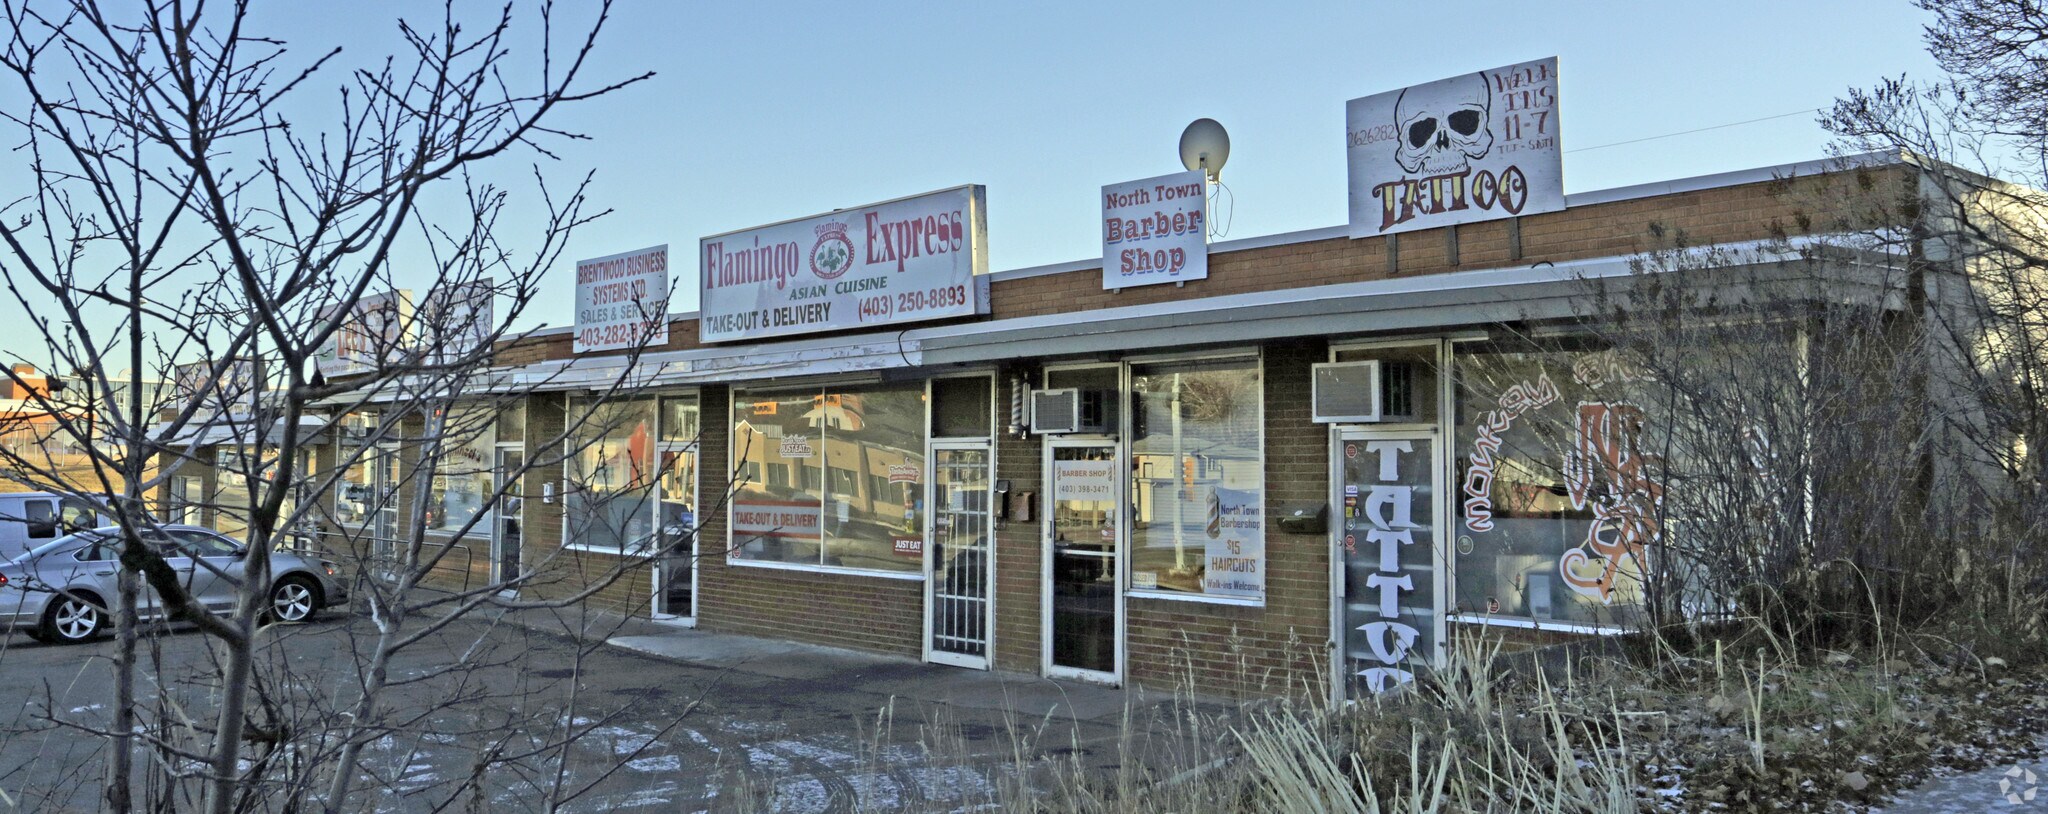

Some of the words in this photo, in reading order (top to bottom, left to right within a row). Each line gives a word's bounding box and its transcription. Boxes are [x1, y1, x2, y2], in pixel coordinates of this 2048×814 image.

[1494, 64, 1557, 93] WALK
[1503, 86, 1554, 113] INS
[1346, 124, 1396, 148] 2626282
[1503, 110, 1548, 142] 11-7
[1106, 189, 1150, 209] North
[1155, 183, 1201, 201] Town
[1372, 165, 1528, 232] TATTOO
[815, 221, 848, 238] Flamingo
[1106, 209, 1202, 244] Barber
[865, 211, 963, 273] Express
[578, 258, 625, 285] BRENTWOOD
[626, 250, 665, 277] BUSINESS
[706, 234, 799, 291] Flamingo
[1121, 247, 1186, 275] Shop
[592, 281, 629, 306] SYSTEMS
[630, 279, 648, 301] LTD.
[789, 284, 828, 300] ASIAN
[834, 276, 888, 295] CUISINE
[580, 307, 608, 325] SALES
[611, 306, 617, 320] &
[858, 295, 893, 322] (403)
[898, 284, 966, 313] 250-8893
[706, 311, 759, 334] TAKE-OUT
[761, 308, 770, 328] &
[773, 302, 832, 328] DELIVERY
[1059, 485, 1076, 494] (403)
[1078, 485, 1109, 493] 398-3471
[735, 511, 771, 525] TAKE-OUT
[772, 513, 778, 526] &
[780, 513, 818, 527] DELIVERY
[1221, 504, 1241, 515] North
[1242, 504, 1260, 516] Town
[1220, 517, 1261, 531] Barbershop
[895, 539, 909, 549] JUST
[910, 540, 922, 550] EAT
[1227, 539, 1241, 555] $15
[1211, 557, 1256, 573] HAIRCUTS
[1206, 579, 1232, 590] Walk-ins
[1233, 581, 1260, 592] Welcome
